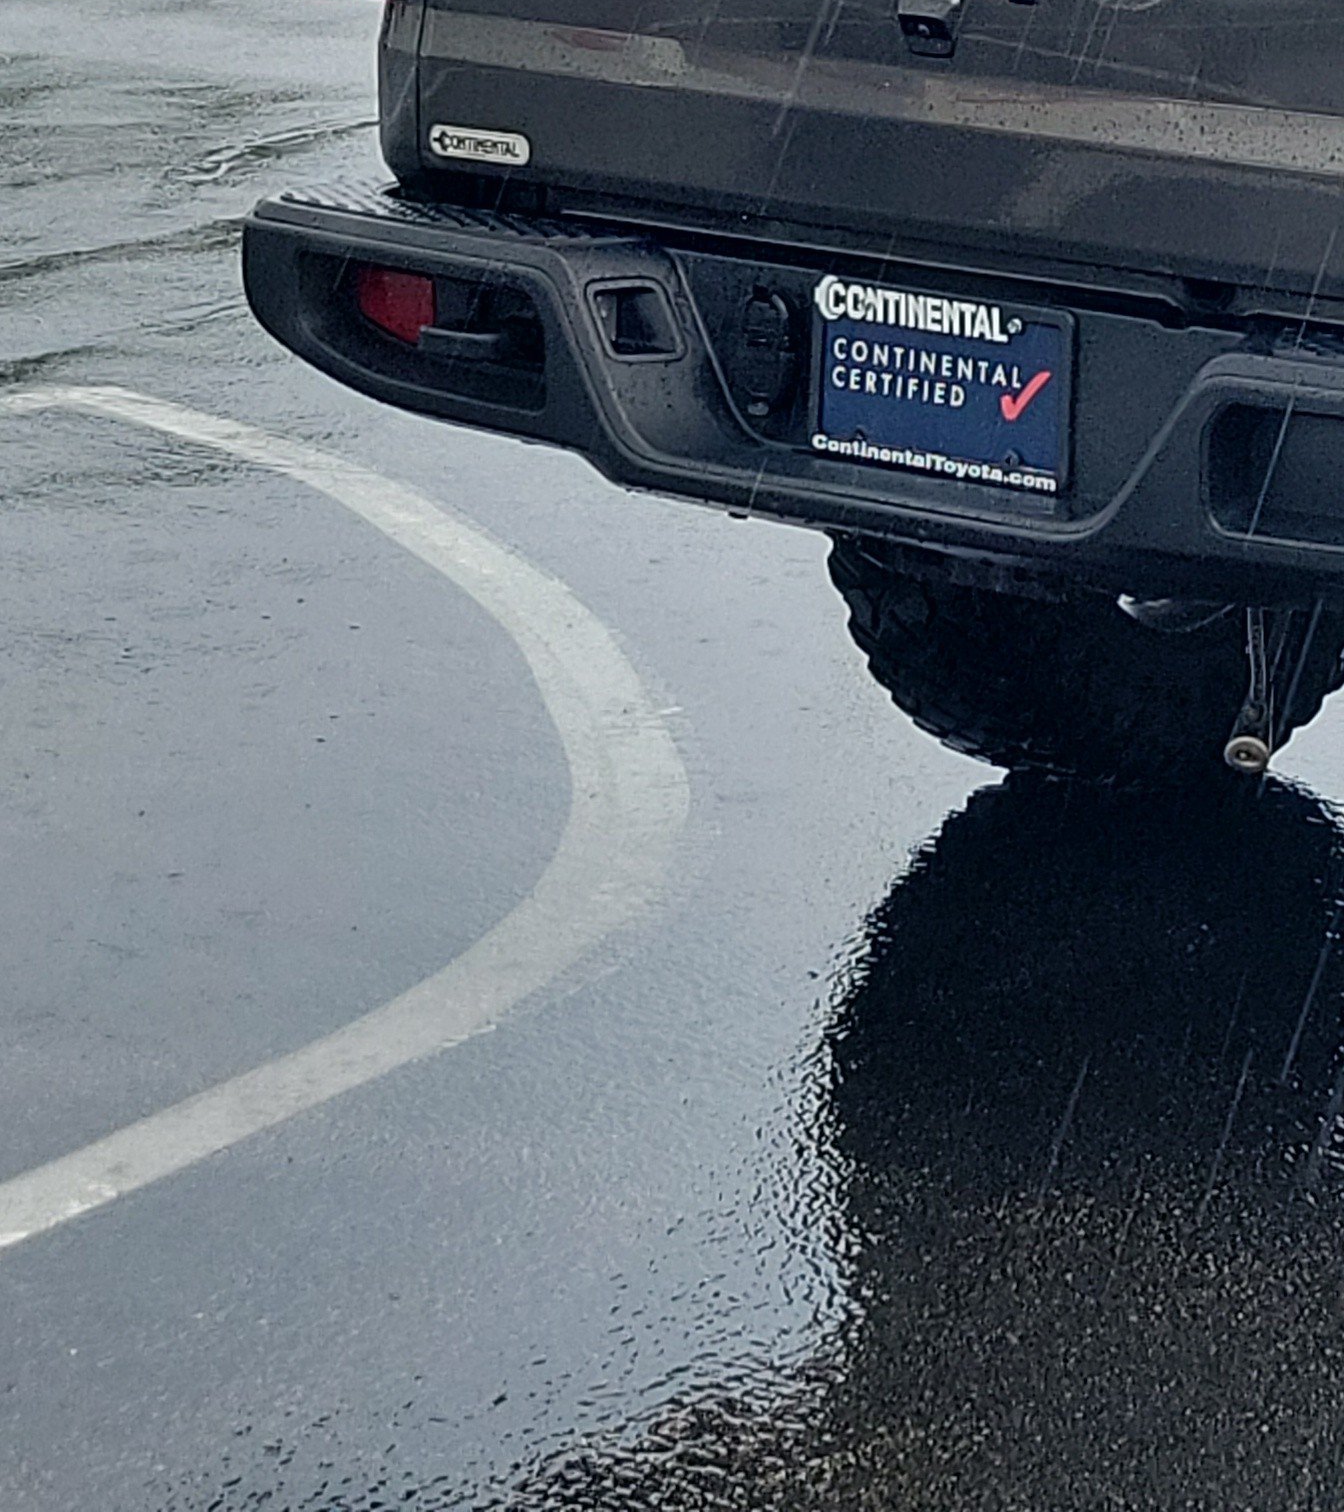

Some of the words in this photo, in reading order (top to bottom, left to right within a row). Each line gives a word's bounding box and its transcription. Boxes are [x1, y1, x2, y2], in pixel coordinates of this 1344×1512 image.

[814, 274, 1009, 344] CONTINENTAL
[831, 365, 965, 408] CERTIFIED
[833, 337, 1022, 389] CONTINENTAL
[811, 433, 1057, 492] ContinentalToyota.com
